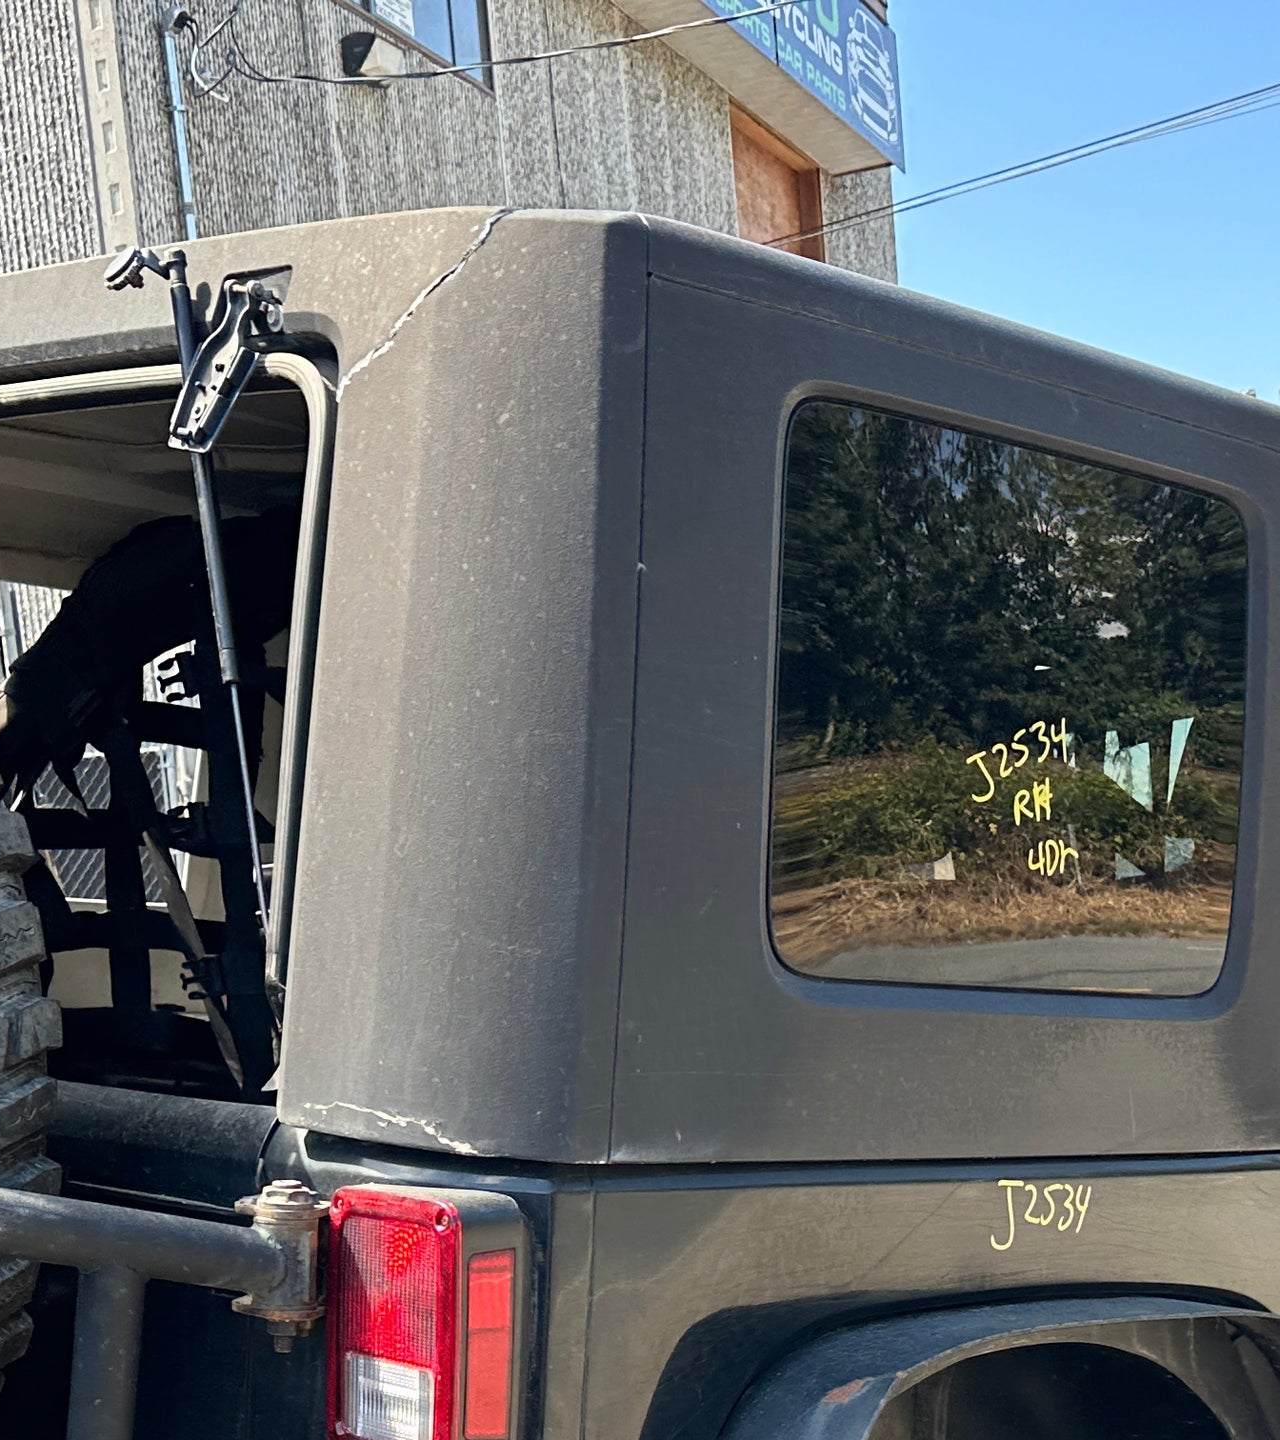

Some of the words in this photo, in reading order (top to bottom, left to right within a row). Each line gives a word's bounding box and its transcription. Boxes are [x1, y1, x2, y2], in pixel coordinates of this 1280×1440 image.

[776, 33, 804, 76] CAR
[806, 62, 847, 111] PARTS
[966, 717, 1068, 803] J2534
[990, 1179, 1092, 1251] J2534
